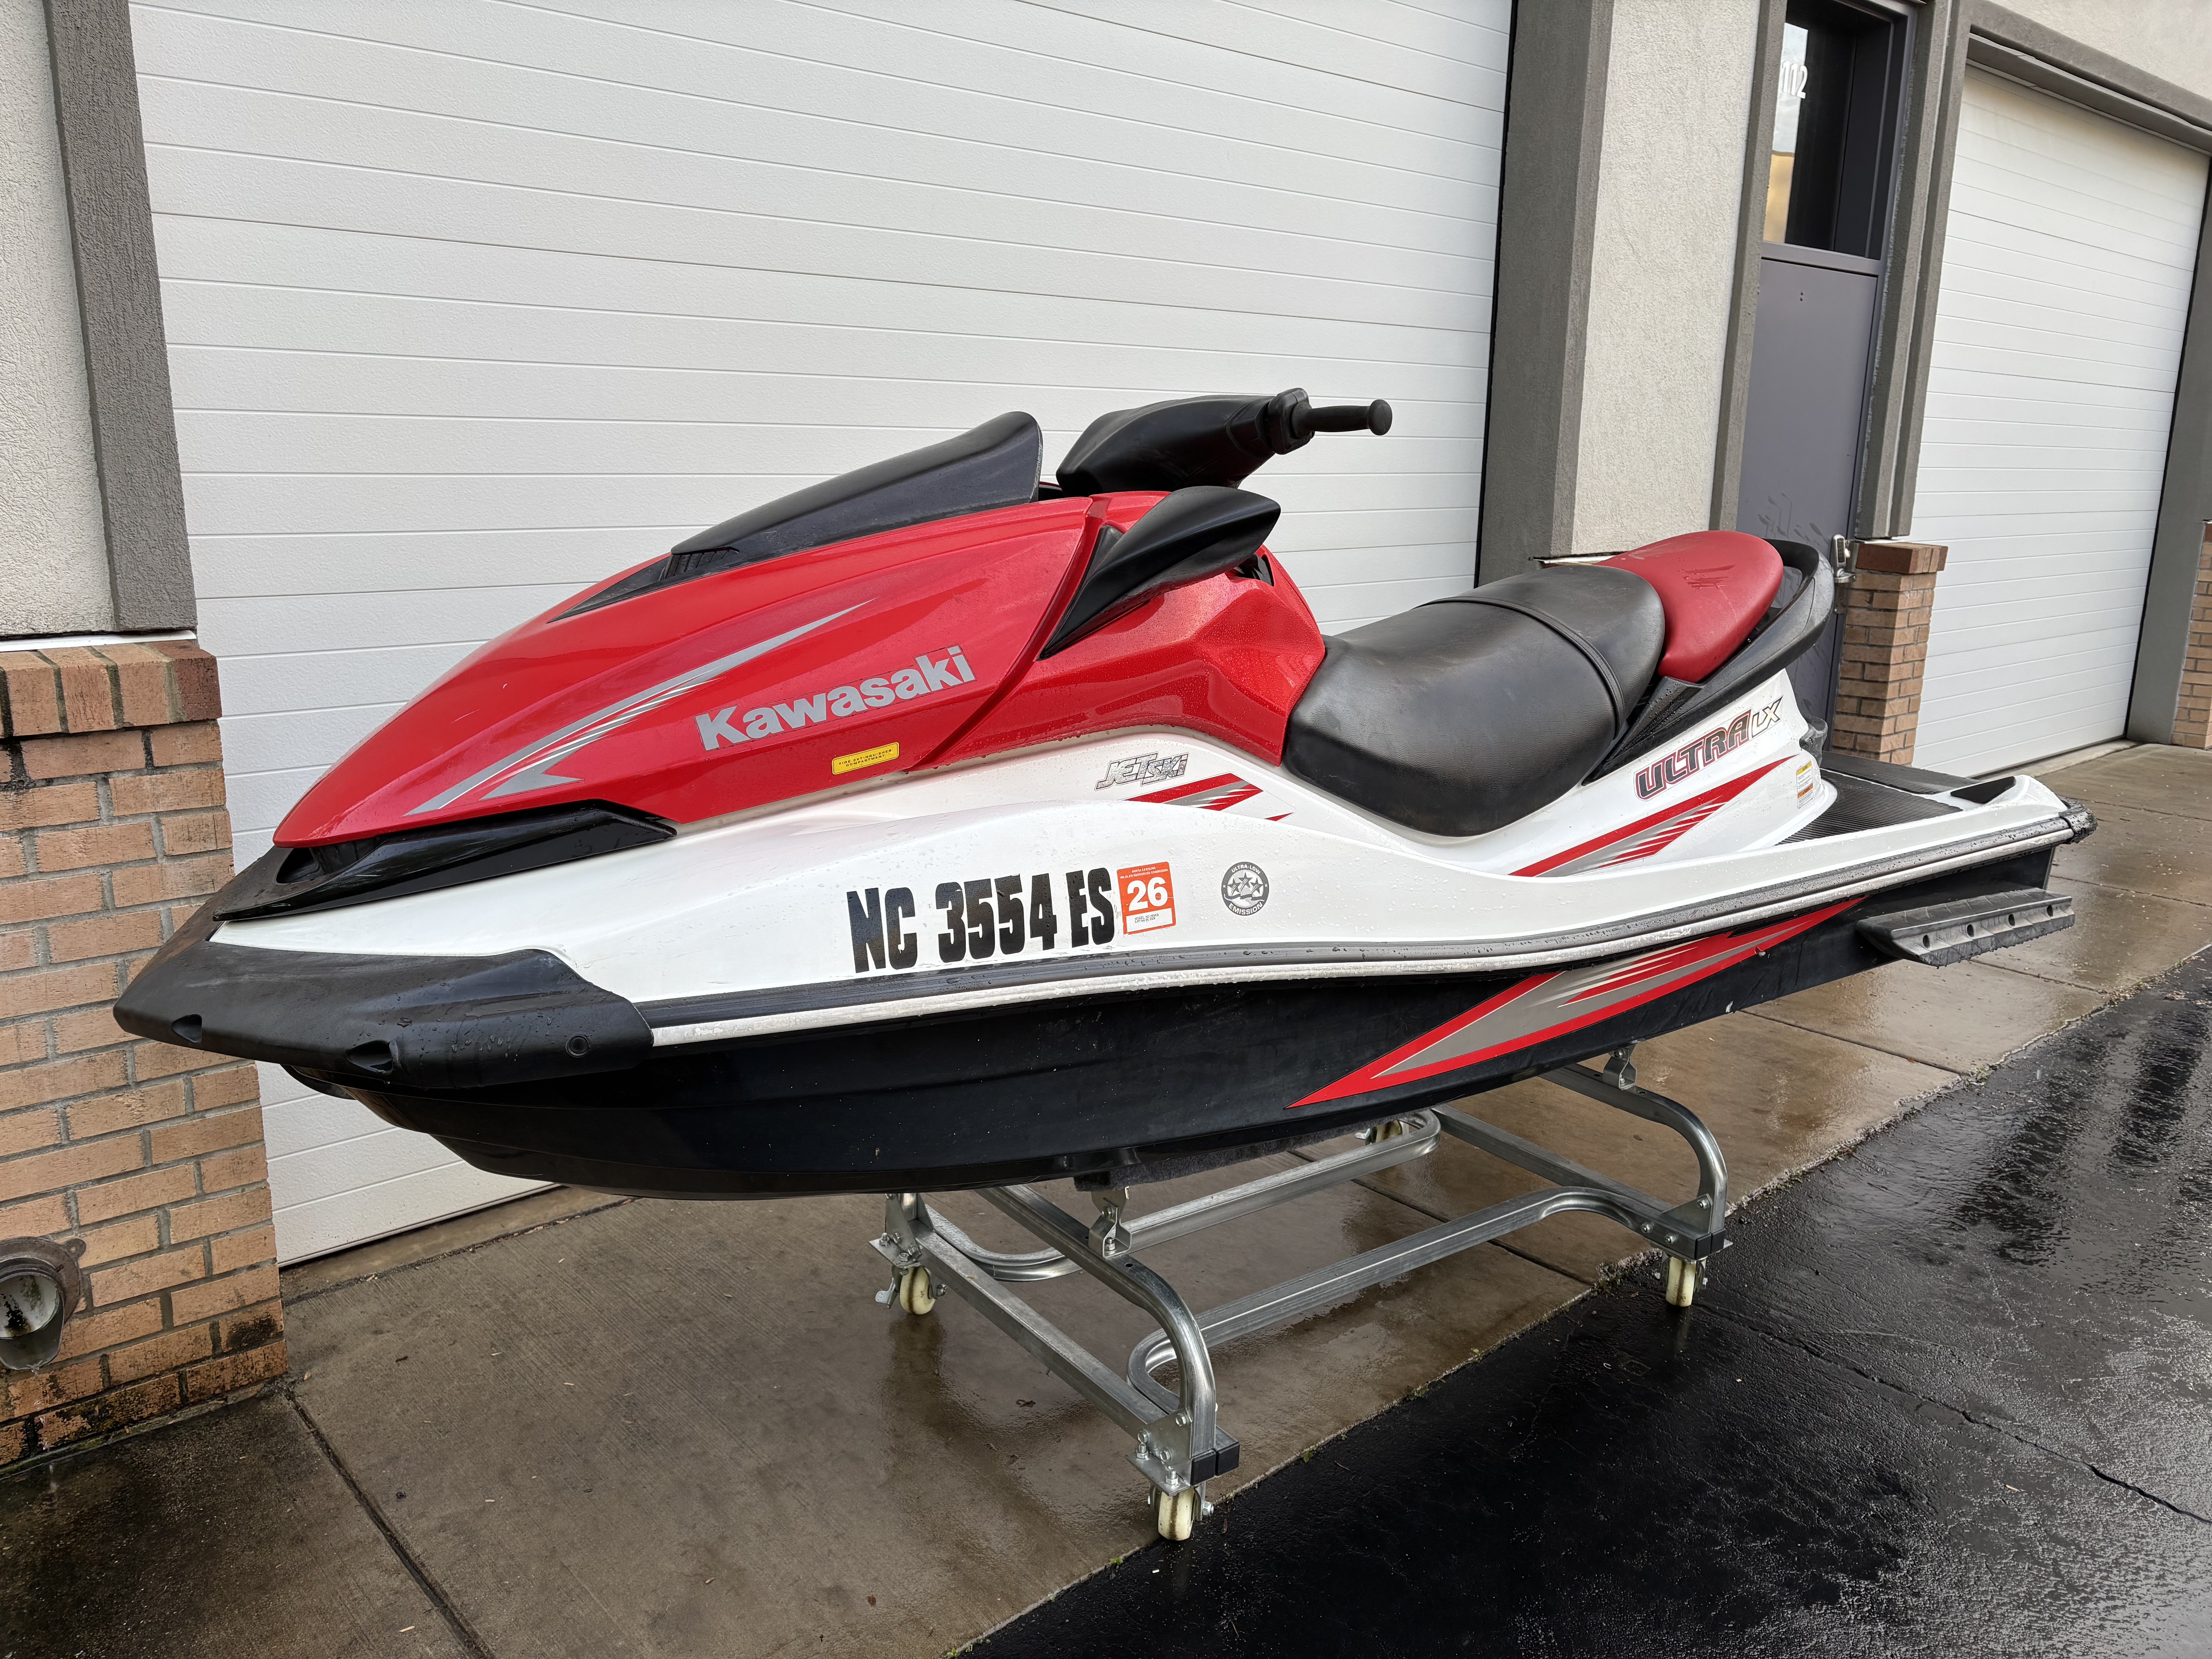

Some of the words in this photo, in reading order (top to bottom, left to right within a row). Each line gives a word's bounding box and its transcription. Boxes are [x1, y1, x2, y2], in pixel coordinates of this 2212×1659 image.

[1782, 60, 1807, 99] 112
[695, 645, 976, 751] Kawasaki
[846, 754, 885, 767] COMPARTMENT
[853, 749, 891, 762] EXTINGUISHER
[1635, 709, 1752, 800] ULTRA
[1752, 696, 1783, 738] LX
[1127, 876, 1168, 911] 26
[1228, 902, 1263, 915] EMISSION
[847, 887, 917, 973] NC
[935, 873, 1057, 963] 3554
[1066, 867, 1115, 948] ES
